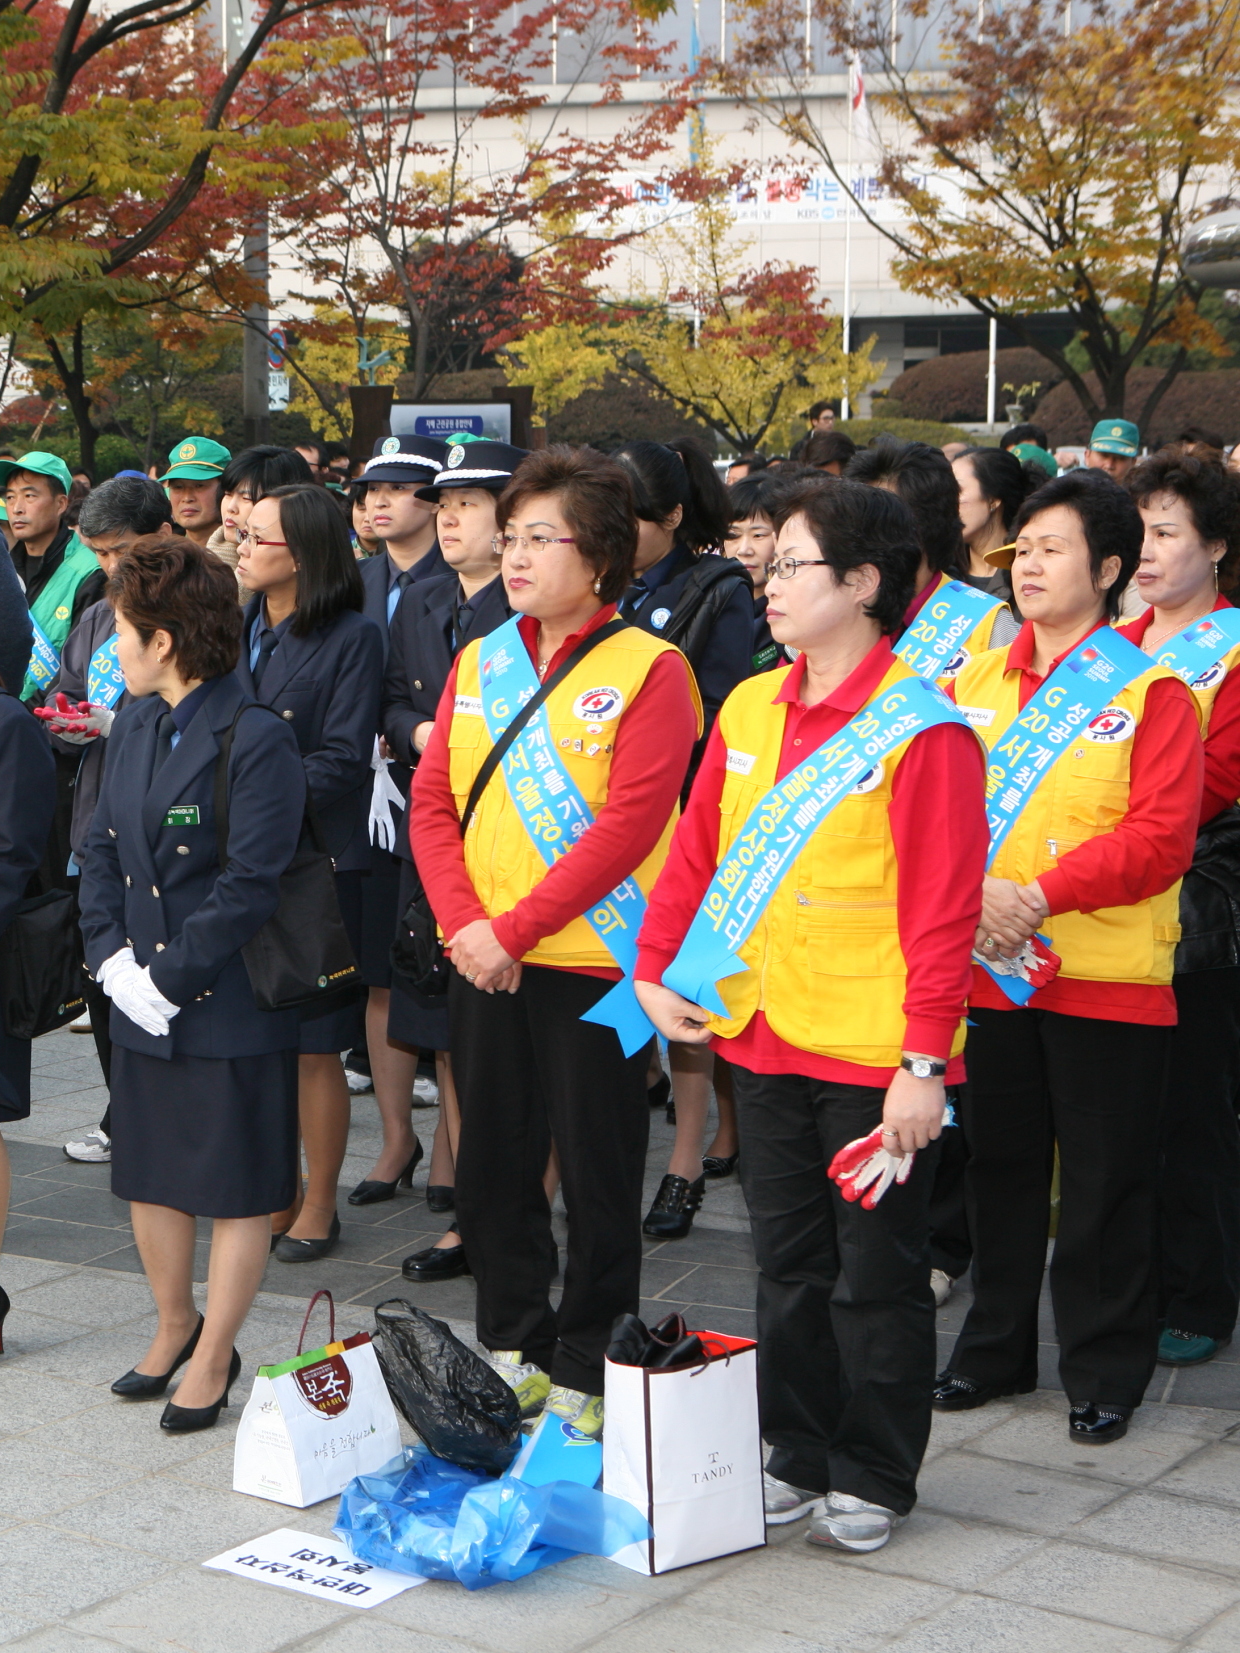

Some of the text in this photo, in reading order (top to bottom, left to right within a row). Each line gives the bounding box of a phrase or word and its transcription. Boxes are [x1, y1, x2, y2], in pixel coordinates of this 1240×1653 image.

[797, 208, 819, 218] KBS
[934, 615, 972, 655] 성공
[1209, 630, 1224, 640] G20
[1089, 668, 1110, 683] SUMMIT
[1092, 664, 1110, 678] SEOUL
[1097, 660, 1114, 673] G20
[1047, 703, 1091, 744] 성공
[526, 727, 567, 797] 개최를
[999, 745, 1054, 813] 개최를
[703, 738, 854, 932] 서울정상회의
[724, 712, 923, 950] 성공 개최를 기원합니다
[305, 1370, 346, 1402] 본죽
[708, 1452, 719, 1463] T
[691, 1463, 734, 1484] TANDY
[235, 1554, 372, 1597] 대한적십자
[289, 1548, 374, 1576] 봉사회
